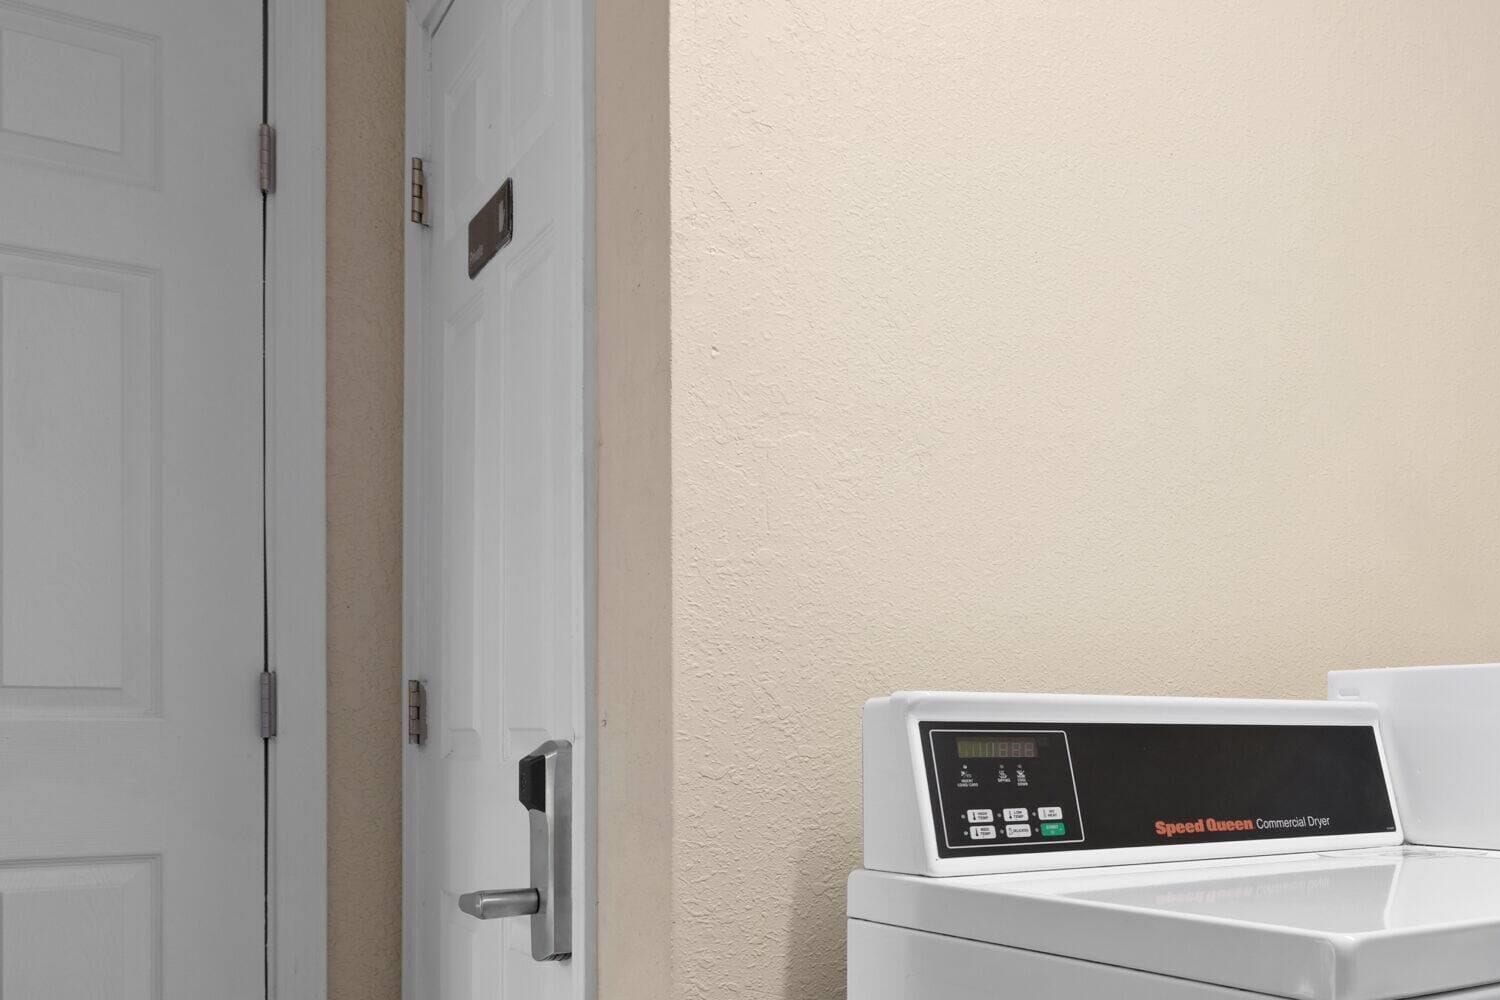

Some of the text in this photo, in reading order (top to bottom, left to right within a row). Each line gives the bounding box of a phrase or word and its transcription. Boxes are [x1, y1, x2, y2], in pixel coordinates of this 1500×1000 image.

[1155, 816, 1331, 837] Speed Queen Commercial Dryer
